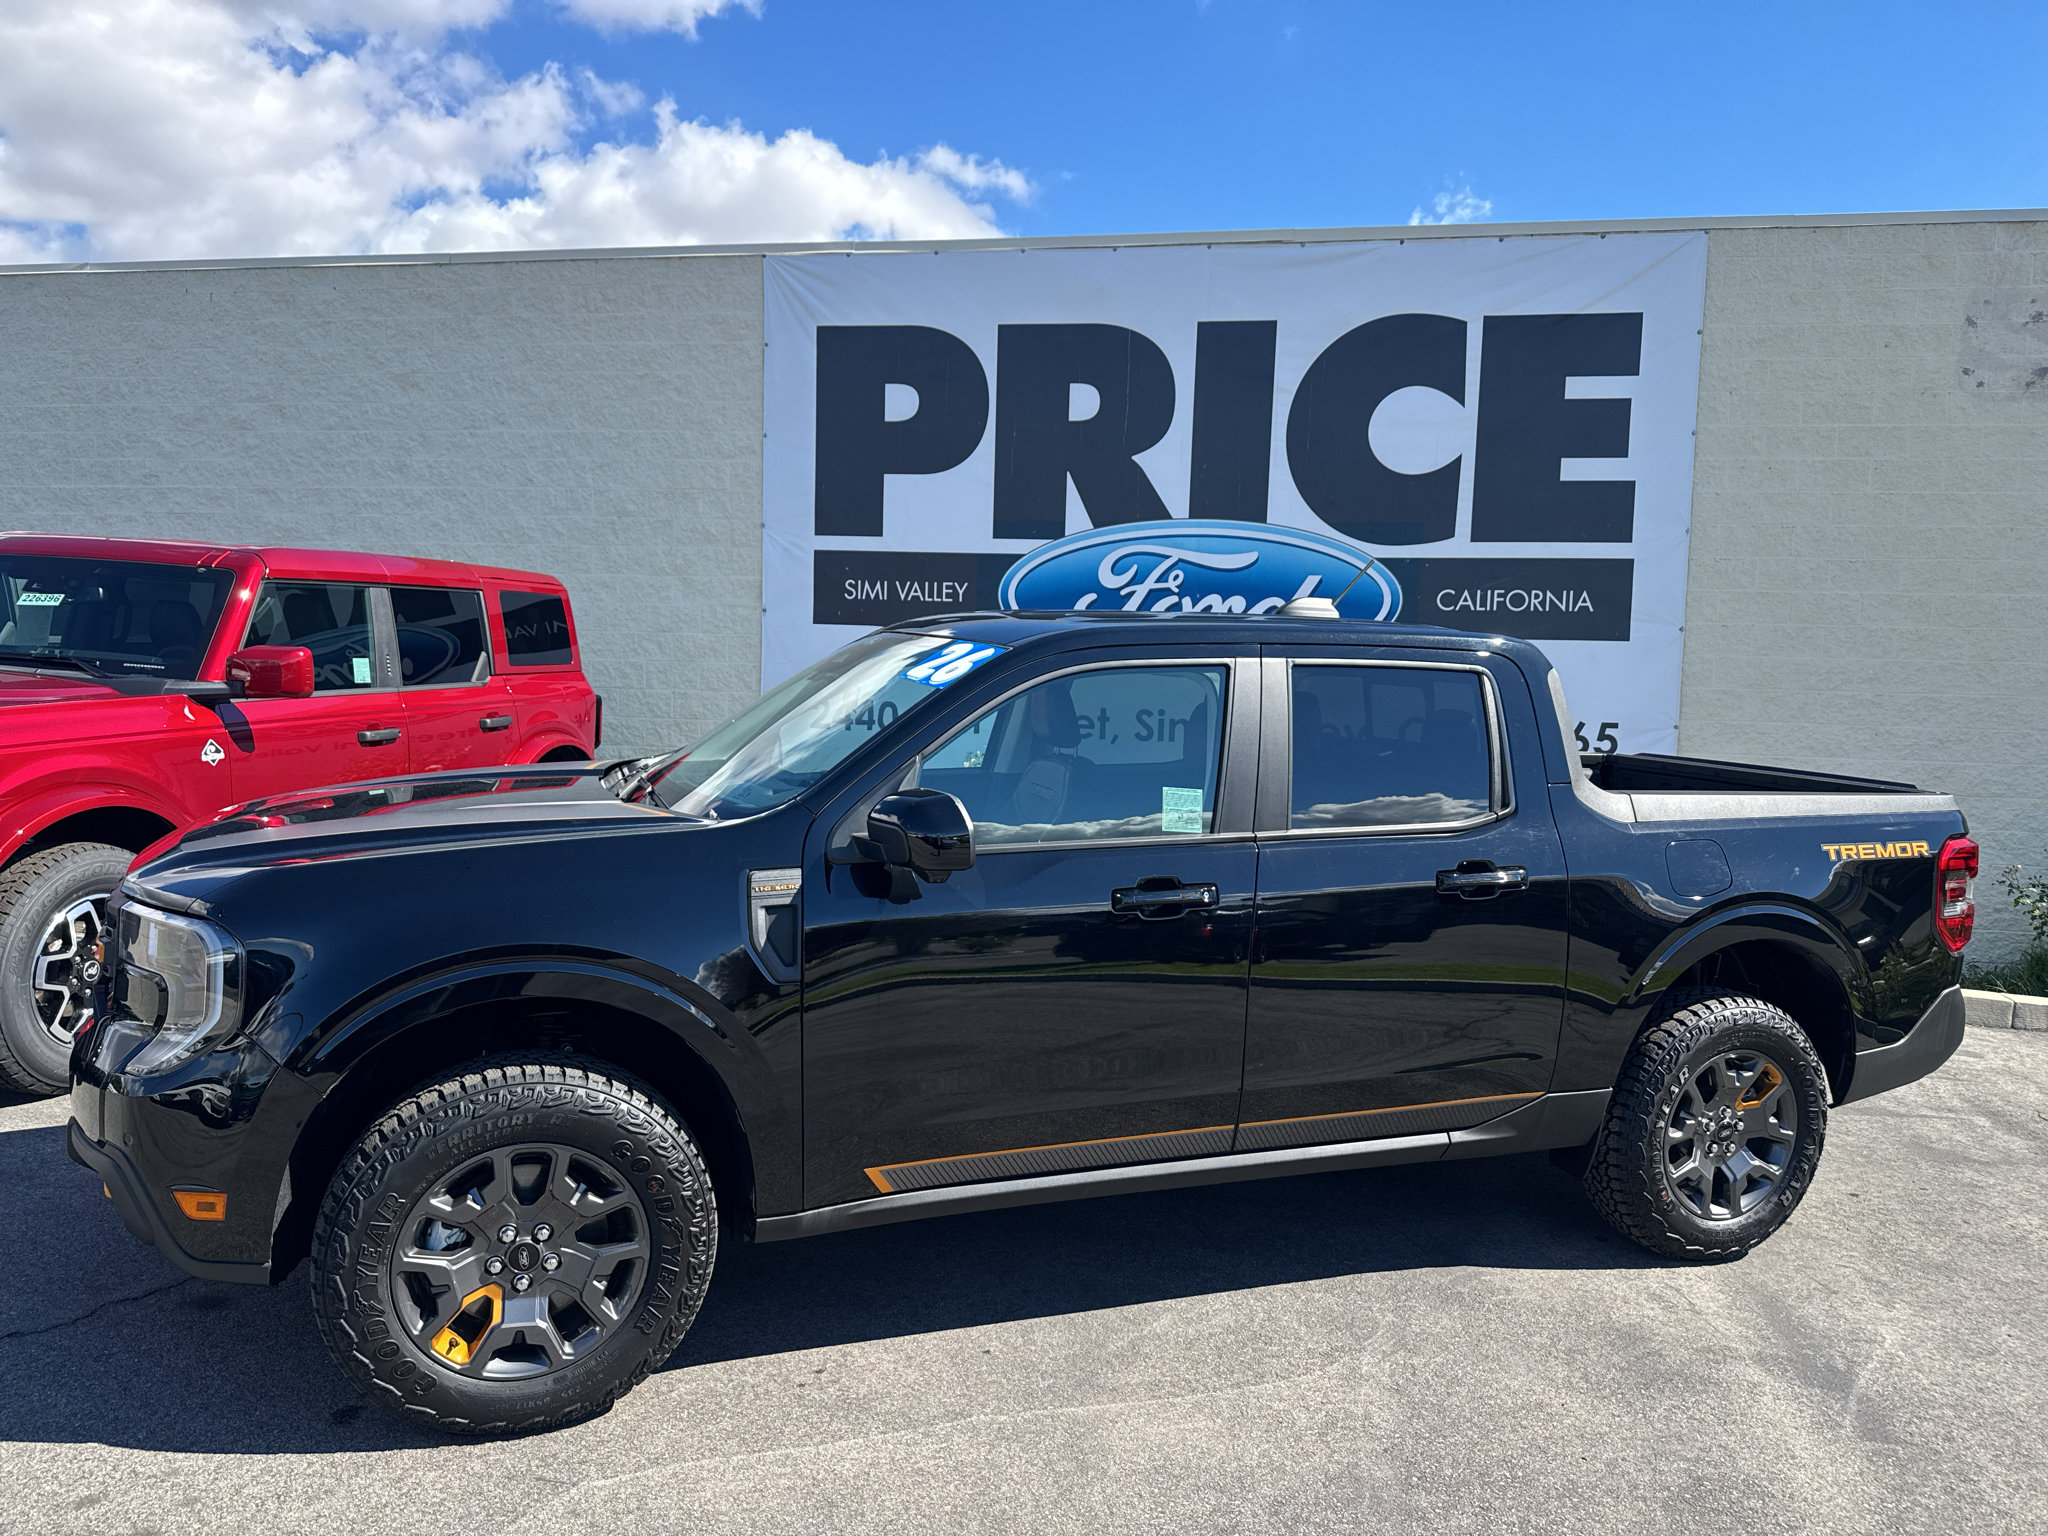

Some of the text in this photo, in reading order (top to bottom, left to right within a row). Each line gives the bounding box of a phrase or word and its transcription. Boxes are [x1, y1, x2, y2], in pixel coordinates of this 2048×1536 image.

[813, 312, 1643, 545] PRICE
[21, 594, 62, 603] 226396
[844, 579, 969, 603] SIMI VALLEY
[1436, 588, 1594, 613] CALIFORNIA
[906, 643, 995, 685] 26
[1820, 840, 1932, 861] TREMOR
[752, 883, 800, 893] TREMOR
[610, 1140, 684, 1337] GOODYEAR
[354, 1192, 439, 1396] GOODYEAR
